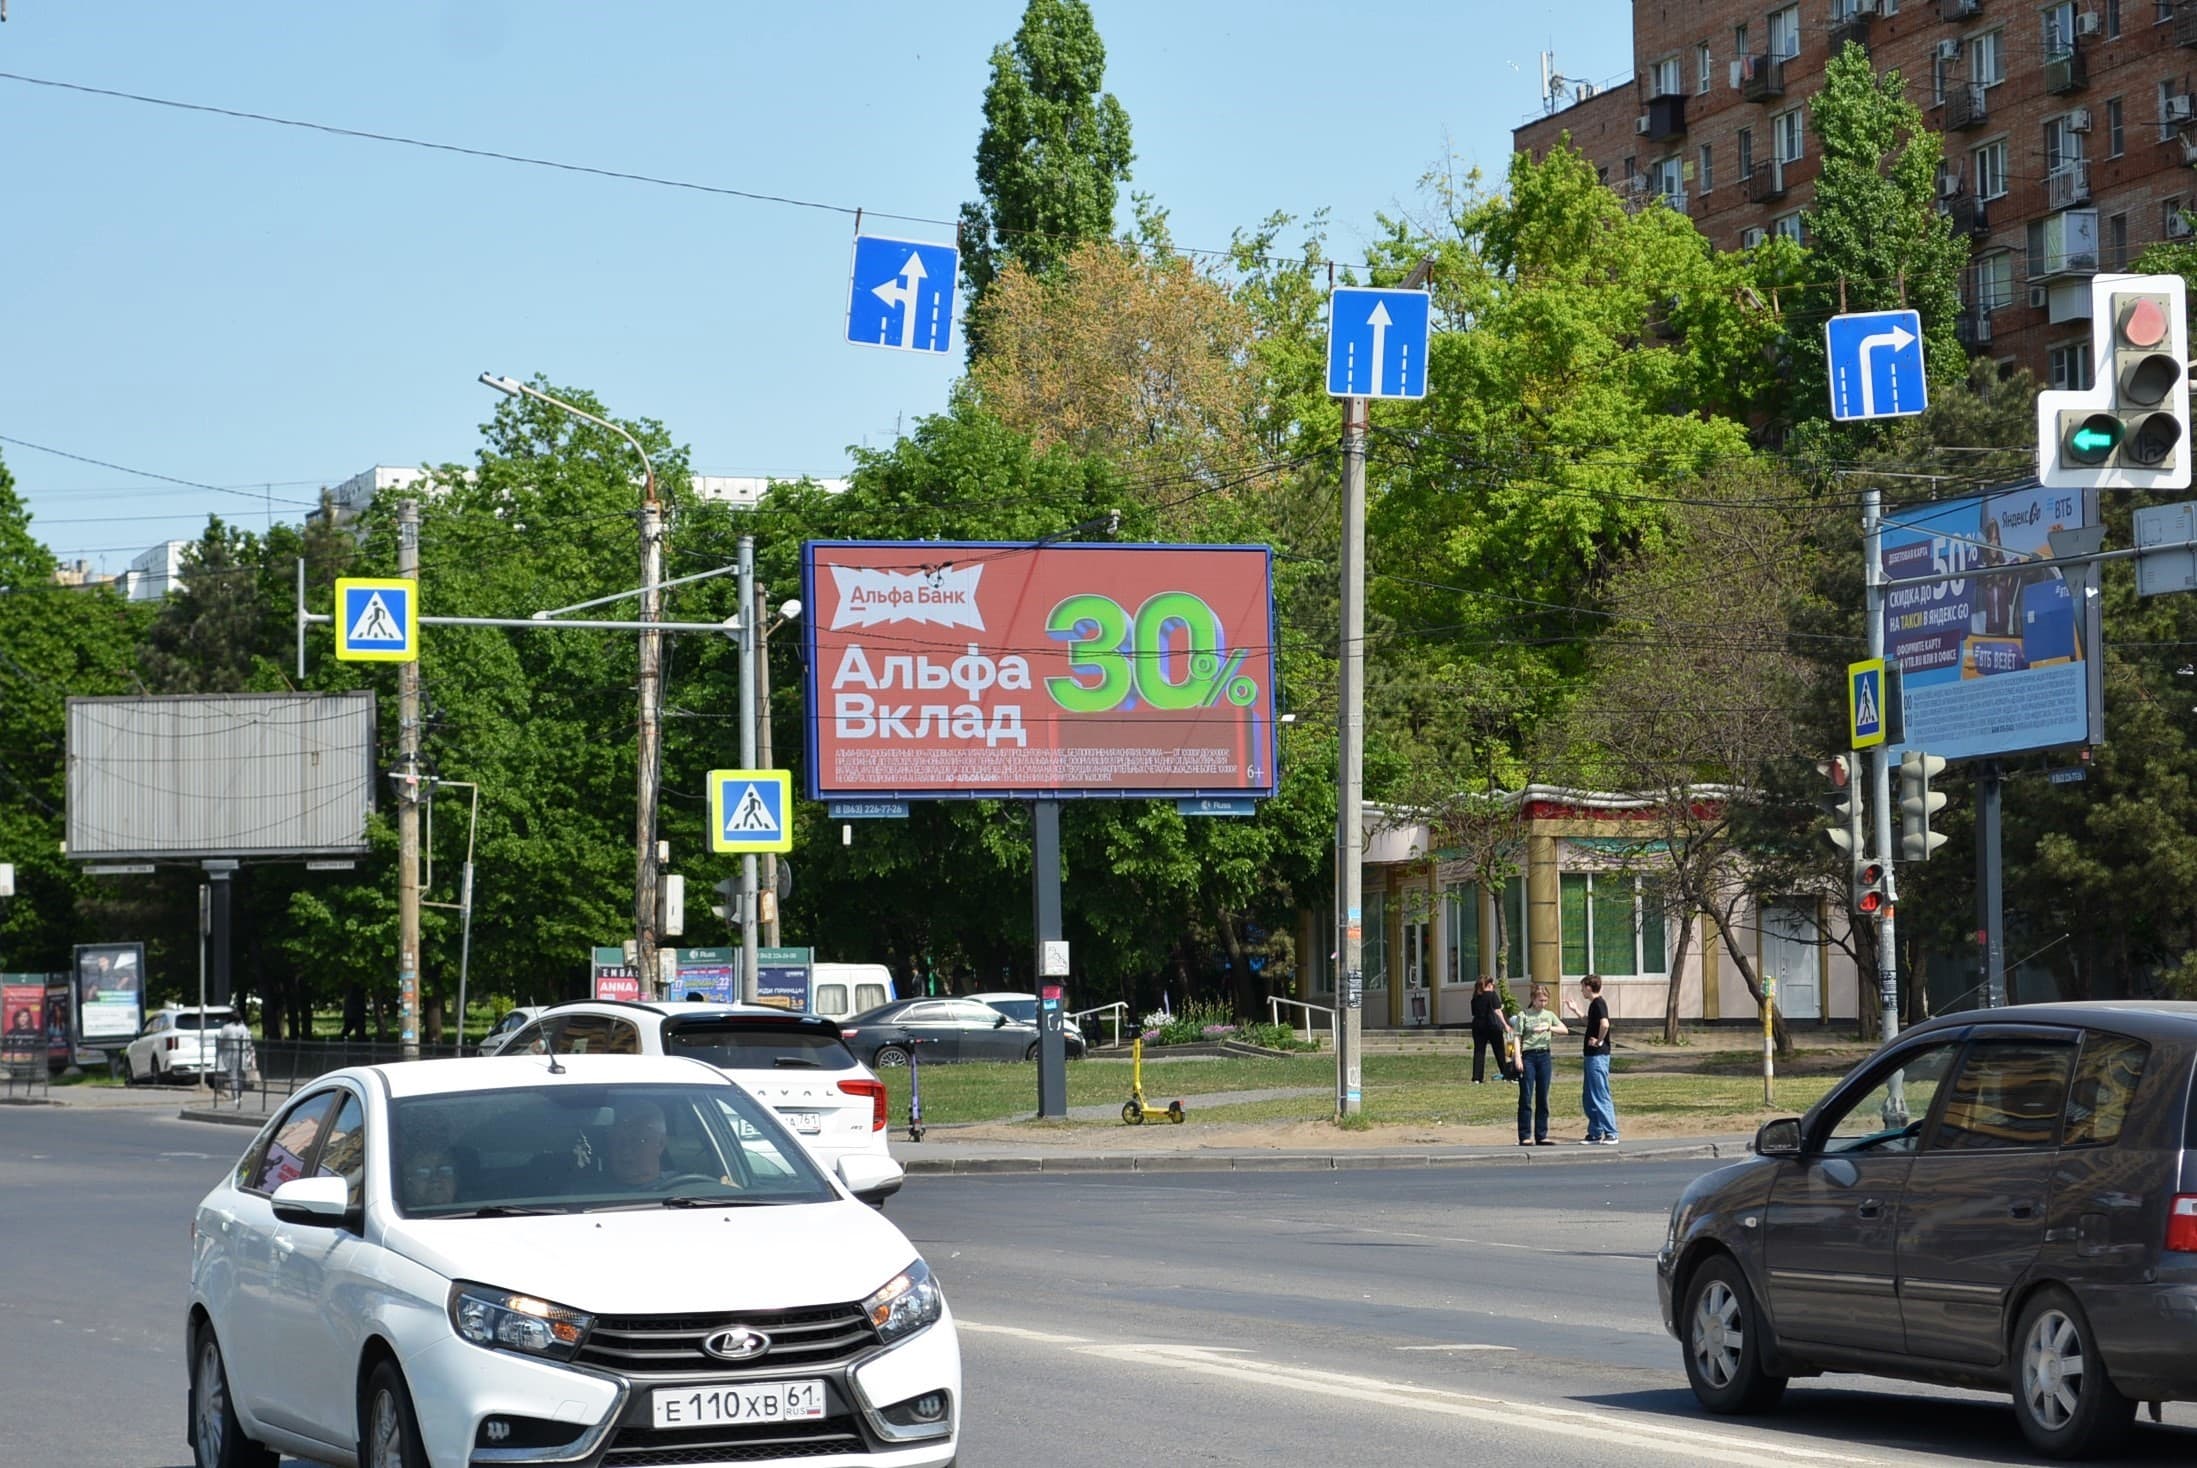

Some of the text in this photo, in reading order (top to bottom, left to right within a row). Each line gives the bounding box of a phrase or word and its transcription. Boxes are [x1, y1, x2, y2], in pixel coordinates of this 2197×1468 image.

[2054, 496, 2073, 519] ВТБ
[2002, 510, 2030, 528] Яндекс
[850, 586, 967, 607] Альфа Банк
[1889, 584, 1932, 609] СКИДКА ДО
[1889, 617, 1900, 633] НА
[1900, 612, 1923, 631] ТАКСИ
[1929, 606, 1958, 627] ЯНДЕКС
[1957, 603, 1969, 621] GO
[1044, 590, 1258, 713] 30%
[1924, 637, 1942, 650] КАРТУ
[1979, 650, 1992, 668] ВТБ
[831, 642, 1032, 702] Альфа
[834, 692, 1027, 748] Вклад
[1247, 764, 1264, 779] 6+
[599, 981, 634, 993] ANNA
[787, 1385, 813, 1407] 61
[786, 1408, 806, 1417] RUS
